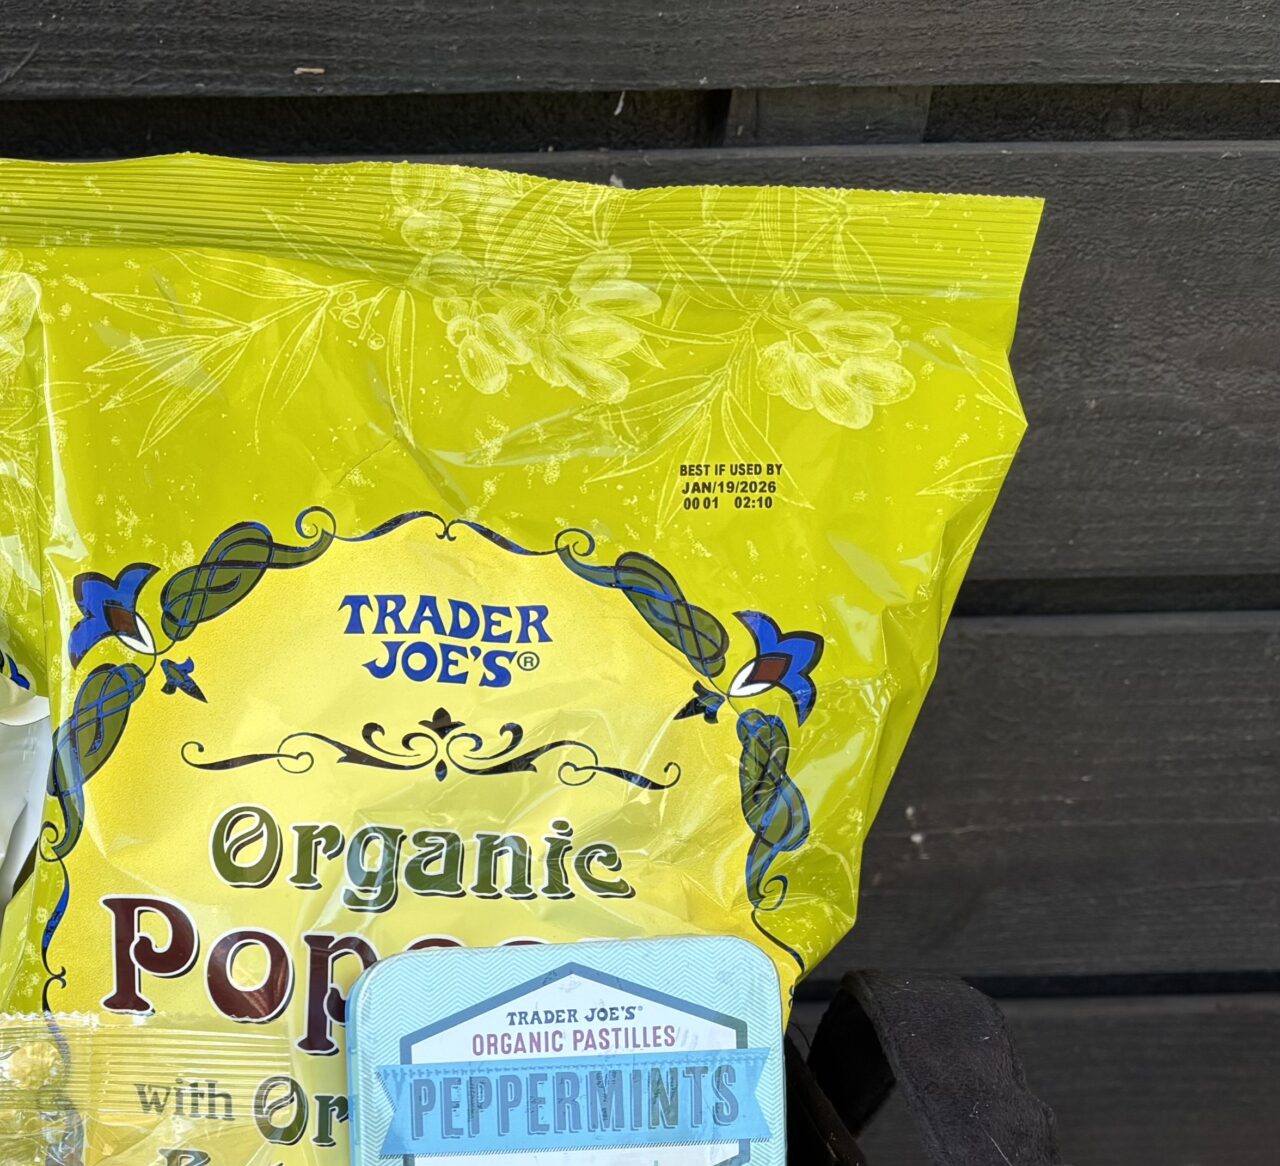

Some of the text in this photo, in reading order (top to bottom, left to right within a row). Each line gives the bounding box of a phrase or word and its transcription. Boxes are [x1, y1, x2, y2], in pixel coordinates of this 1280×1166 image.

[679, 463, 783, 477] BEST IF USED BY
[681, 480, 777, 495] JAN/19/2026
[734, 496, 773, 509] 02:10
[338, 594, 553, 644] TRADER
[211, 804, 636, 913] Organic
[506, 1008, 578, 1026] TRADER
[472, 1025, 676, 1056] ORGANIC PASTILLES
[133, 1075, 350, 1147] with Or
[410, 1064, 738, 1140] PEPPERMINTS
